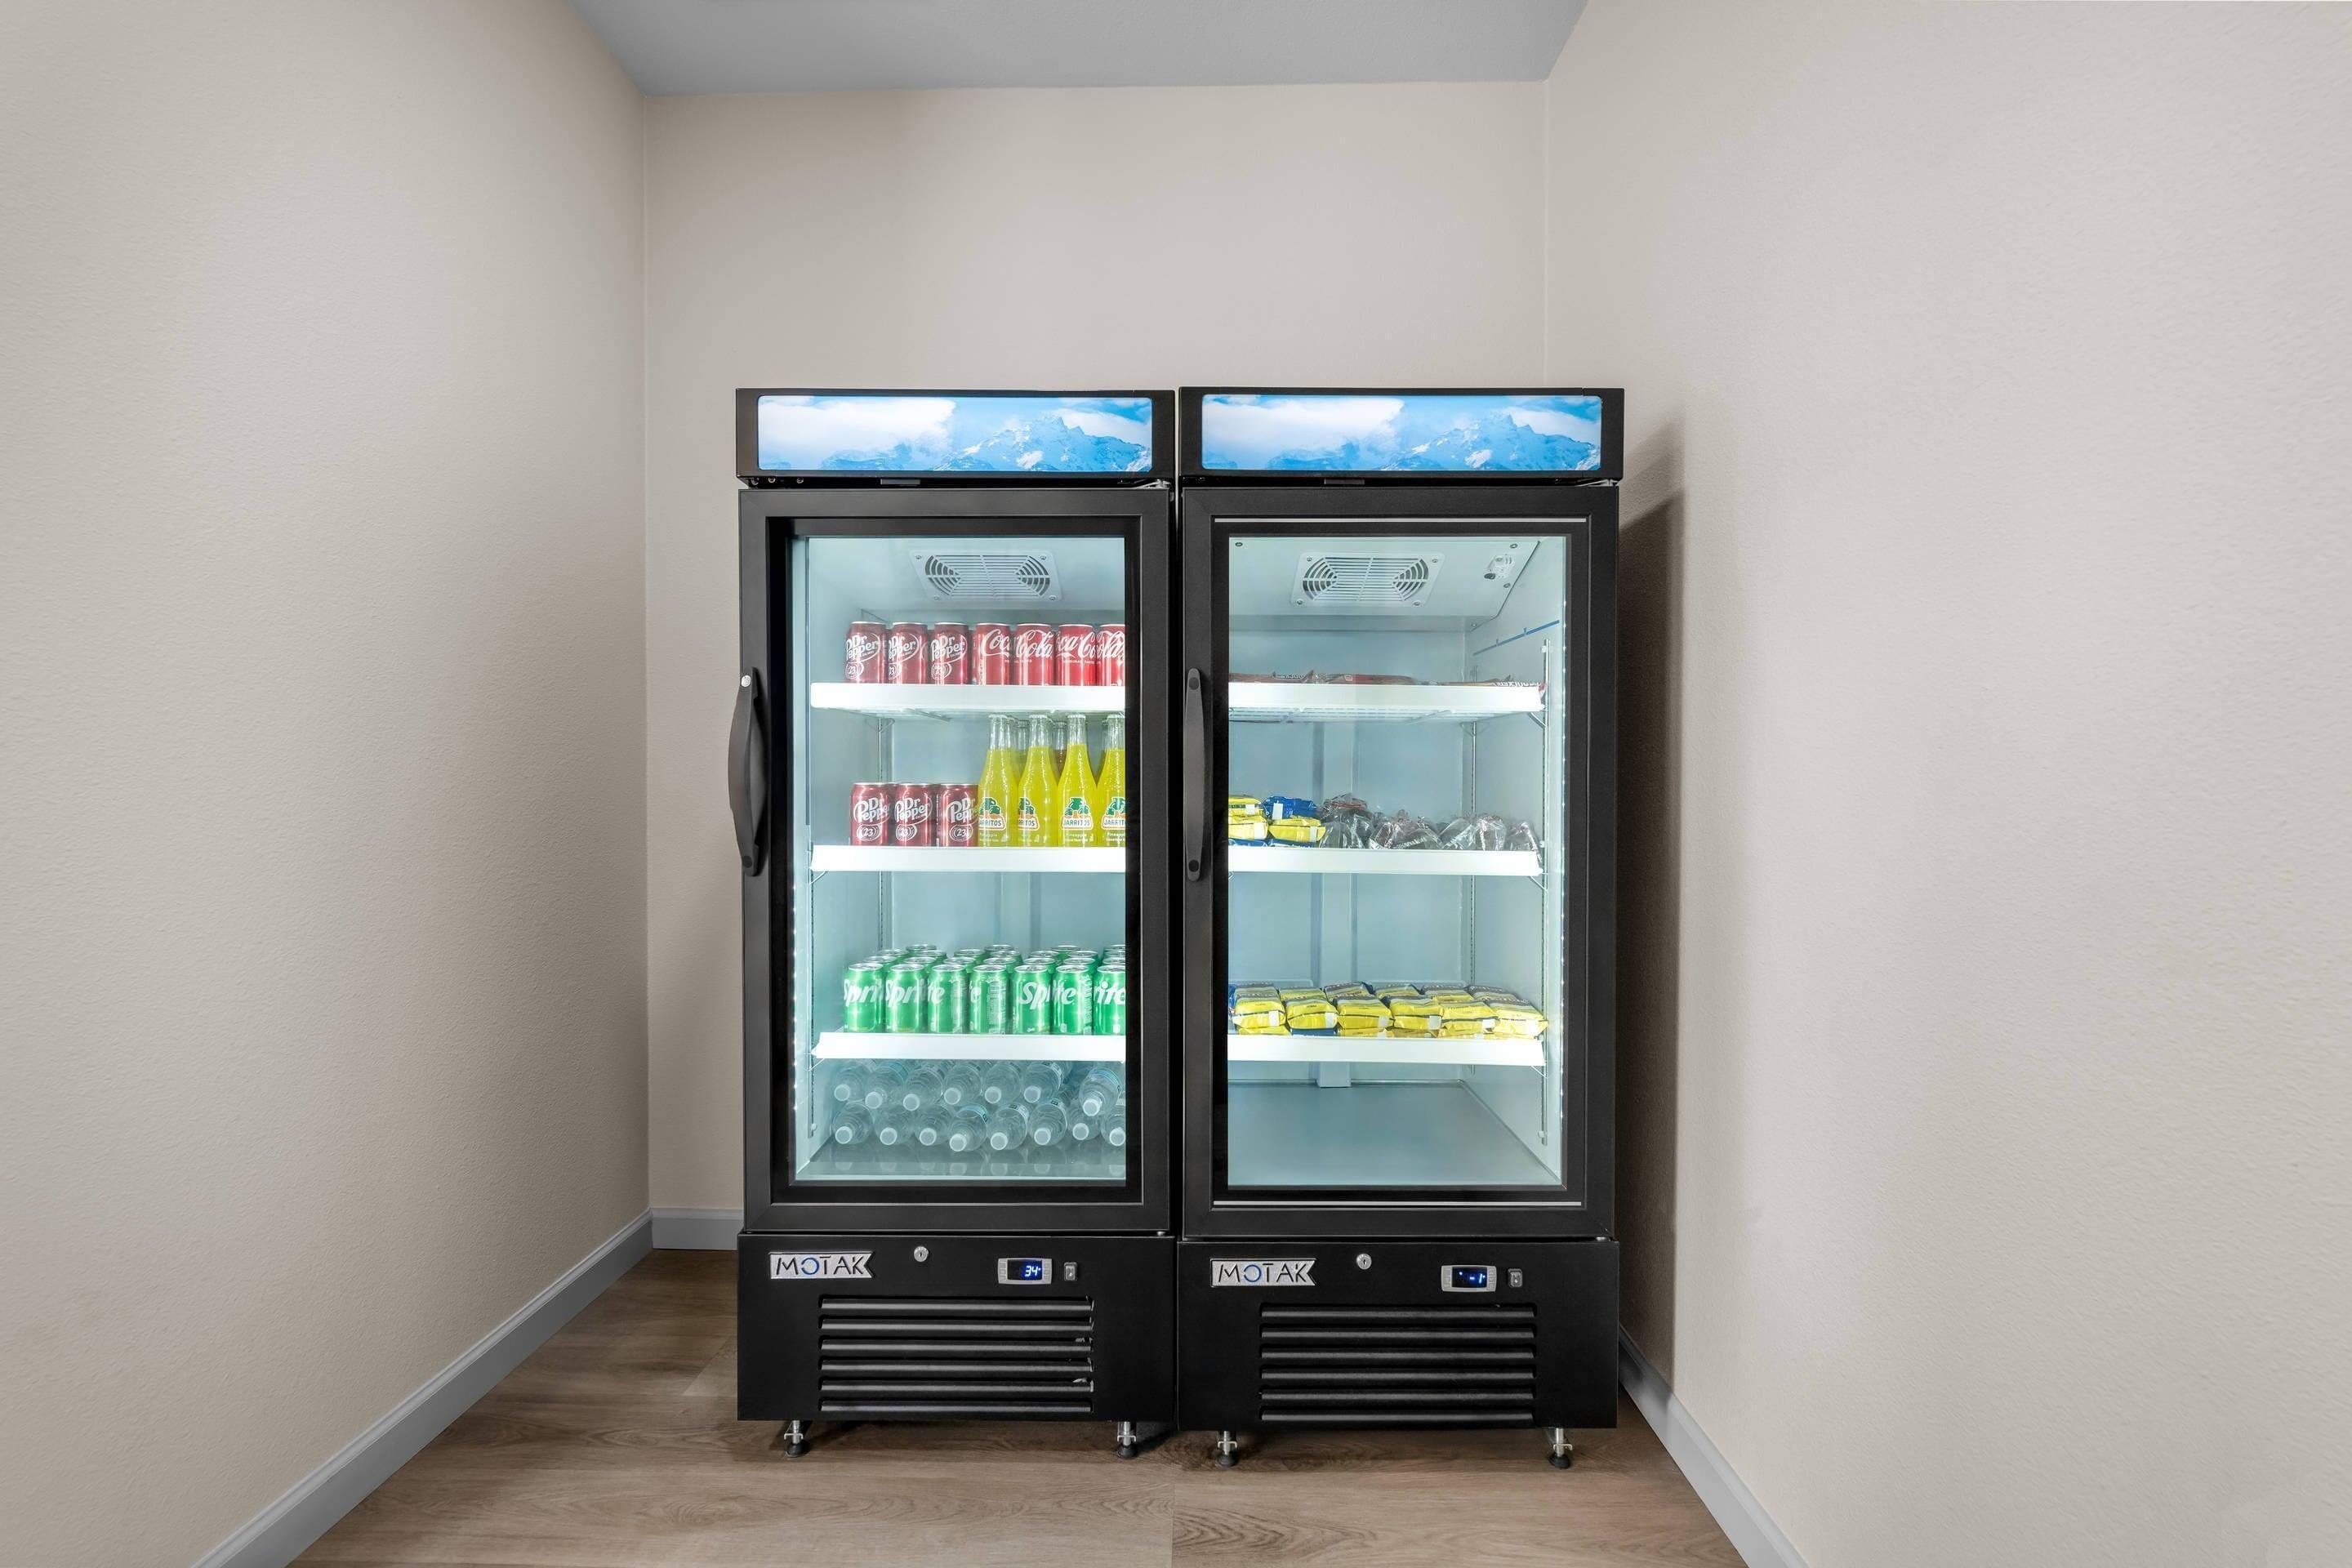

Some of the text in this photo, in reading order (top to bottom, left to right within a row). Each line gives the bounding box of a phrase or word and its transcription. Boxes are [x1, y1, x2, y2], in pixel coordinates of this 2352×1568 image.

[852, 635, 867, 647] Dr
[942, 635, 955, 647] Dr
[931, 638, 965, 661] Pepper
[868, 797, 884, 810] Dr
[903, 797, 920, 810] Dr
[961, 797, 976, 810] Dr
[895, 801, 930, 823] Pepper
[776, 1255, 864, 1276] MOTAK
[1218, 1263, 1307, 1283] MOTAK
